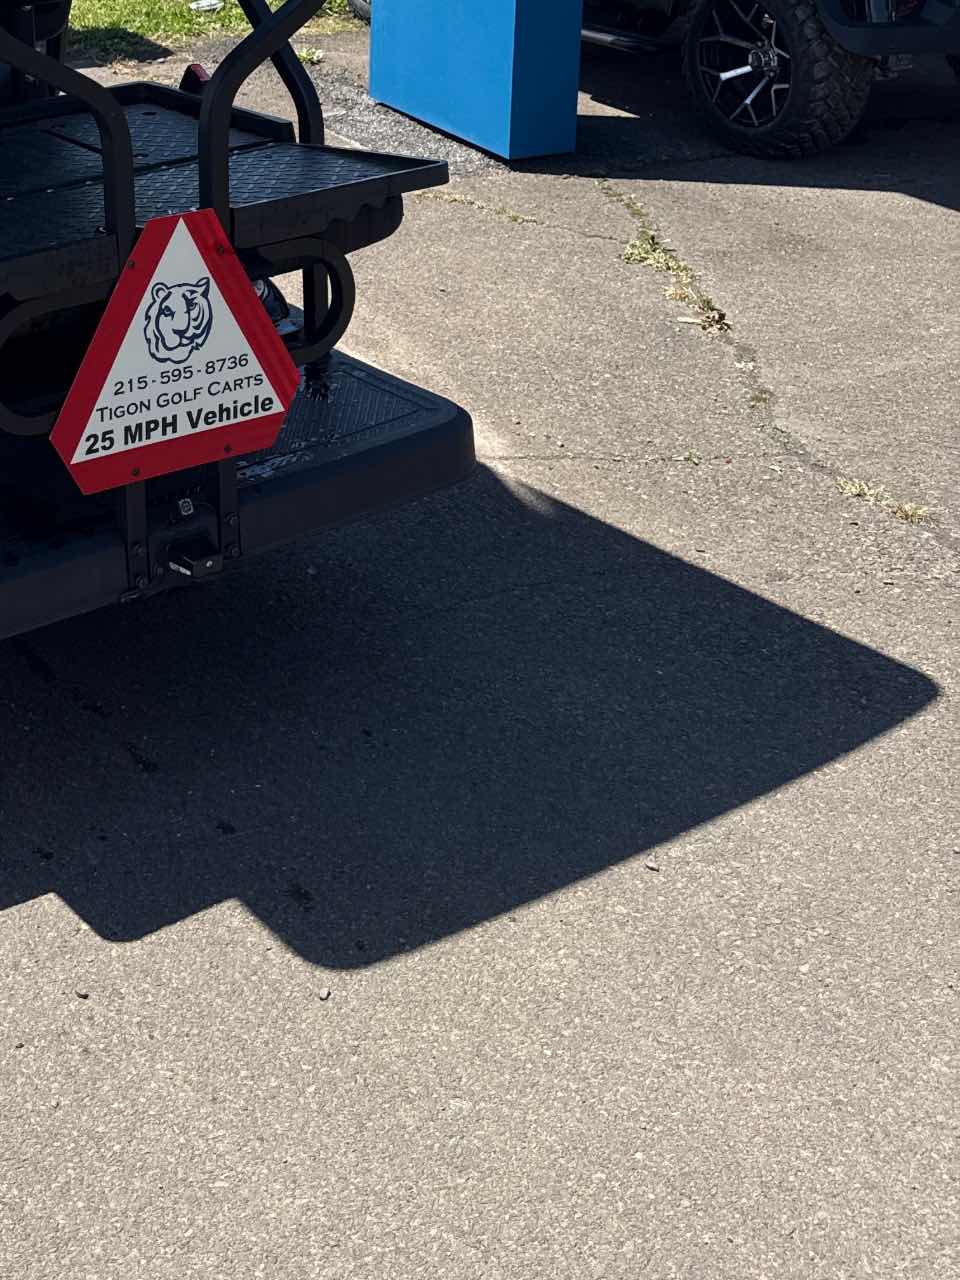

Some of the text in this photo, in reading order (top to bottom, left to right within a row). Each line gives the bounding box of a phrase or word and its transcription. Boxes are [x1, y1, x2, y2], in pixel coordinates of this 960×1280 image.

[85, 395, 274, 455] 25 MPH Vehicle
[96, 374, 264, 422] TIGON GOLF CARTS
